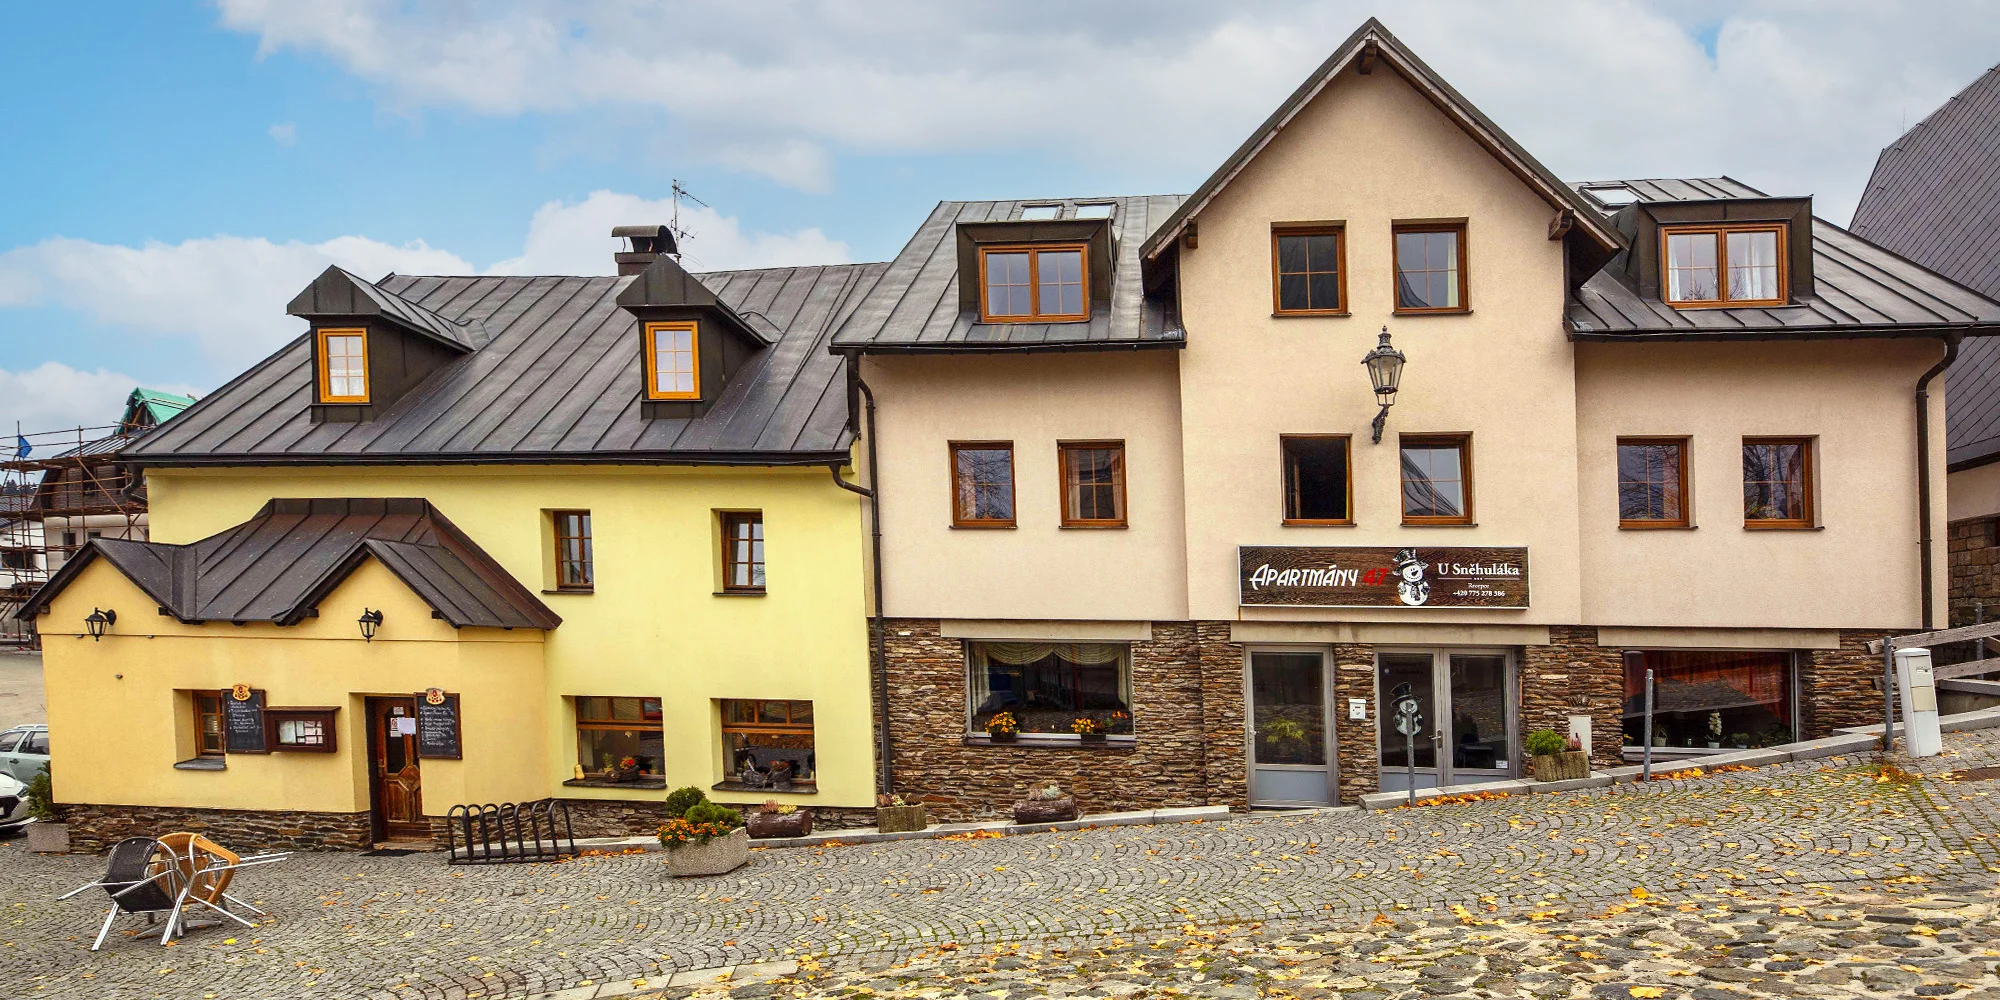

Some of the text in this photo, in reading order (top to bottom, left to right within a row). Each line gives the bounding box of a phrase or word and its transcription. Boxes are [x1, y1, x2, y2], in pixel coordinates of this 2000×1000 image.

[1437, 563, 1520, 575] U Sněhuláka
[1362, 568, 1388, 586] 47
